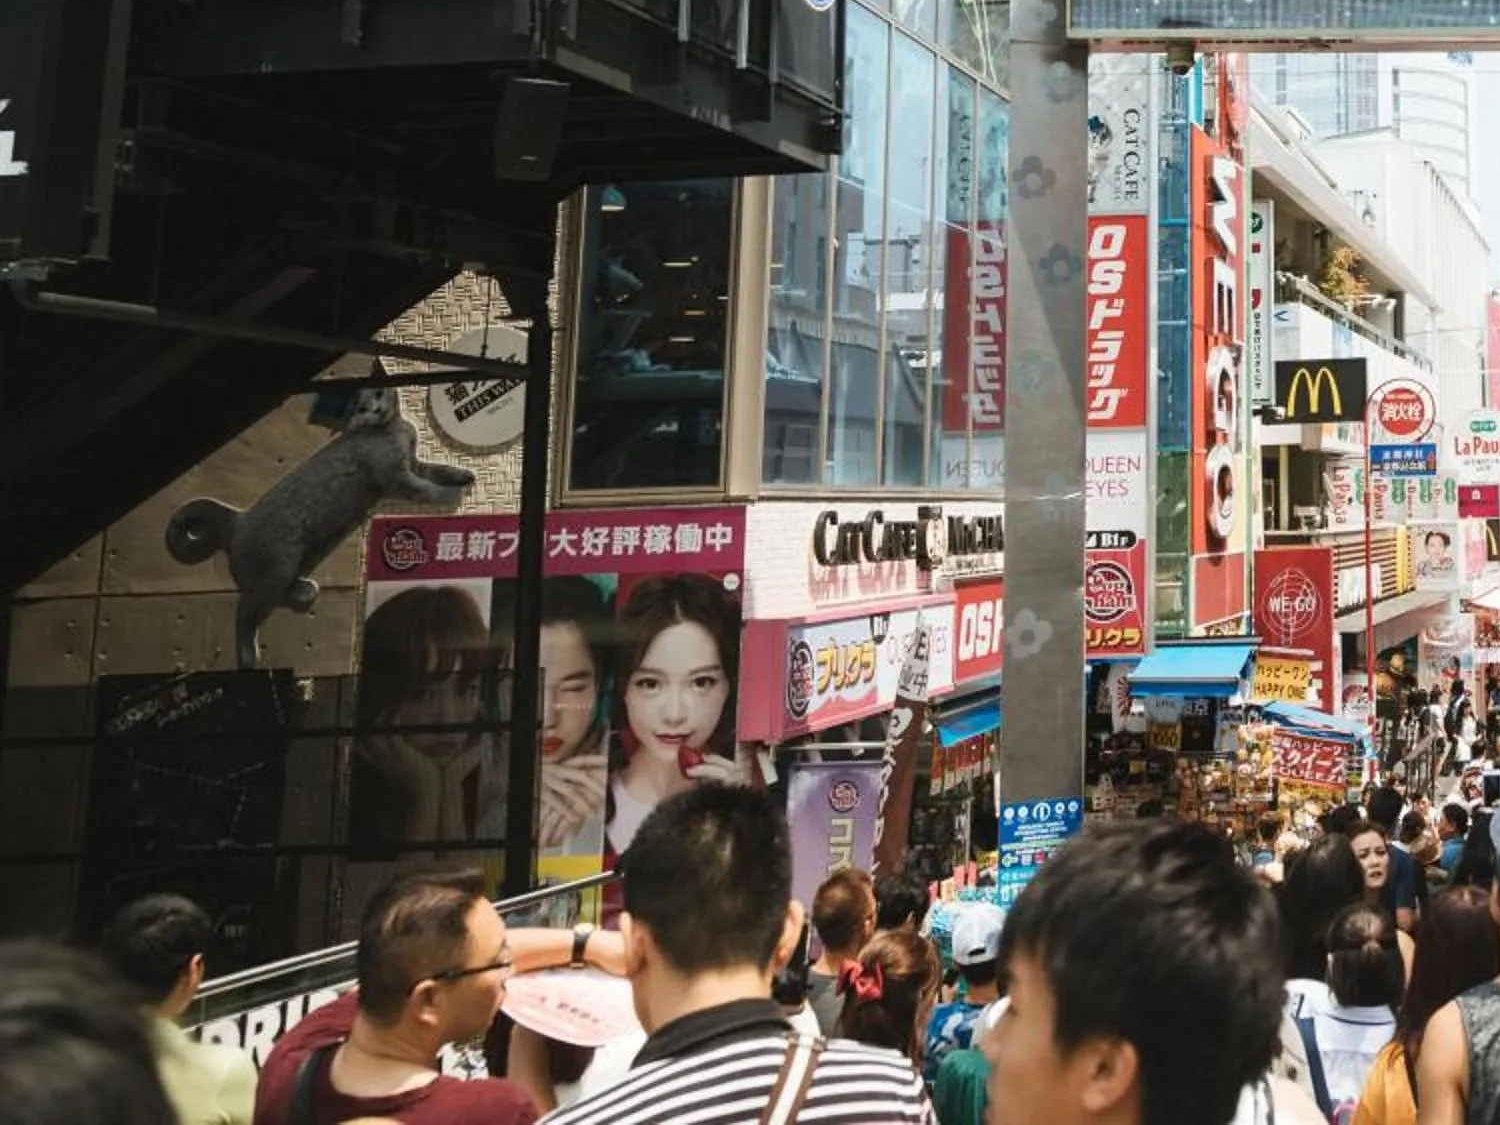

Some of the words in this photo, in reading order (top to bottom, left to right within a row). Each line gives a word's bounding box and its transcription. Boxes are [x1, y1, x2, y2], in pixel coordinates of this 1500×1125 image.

[1087, 224, 1128, 423] OSドラッグ
[1454, 436, 1471, 456] La
[435, 521, 735, 562] 最新プ大好評稼働中
[958, 597, 1004, 663] OS
